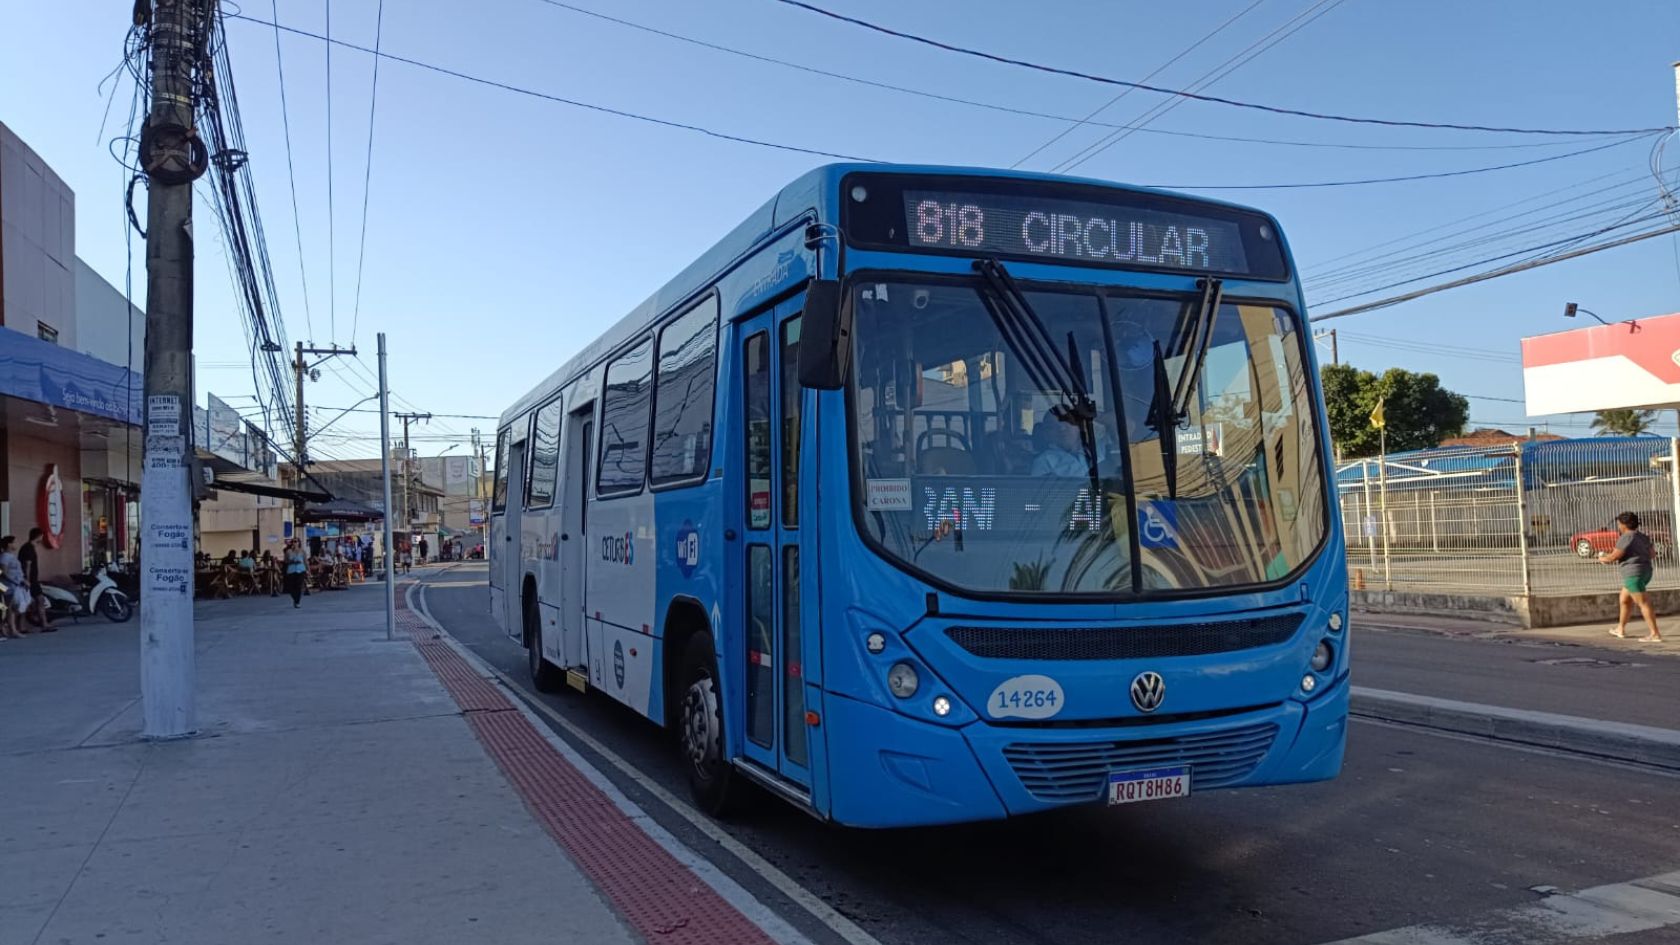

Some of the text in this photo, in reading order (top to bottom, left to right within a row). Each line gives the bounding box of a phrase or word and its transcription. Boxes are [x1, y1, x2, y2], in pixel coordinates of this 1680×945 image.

[916, 200, 1209, 268] 818 CIRCULAR
[998, 690, 1057, 708] 14264
[1116, 777, 1182, 800] RQT8H86
